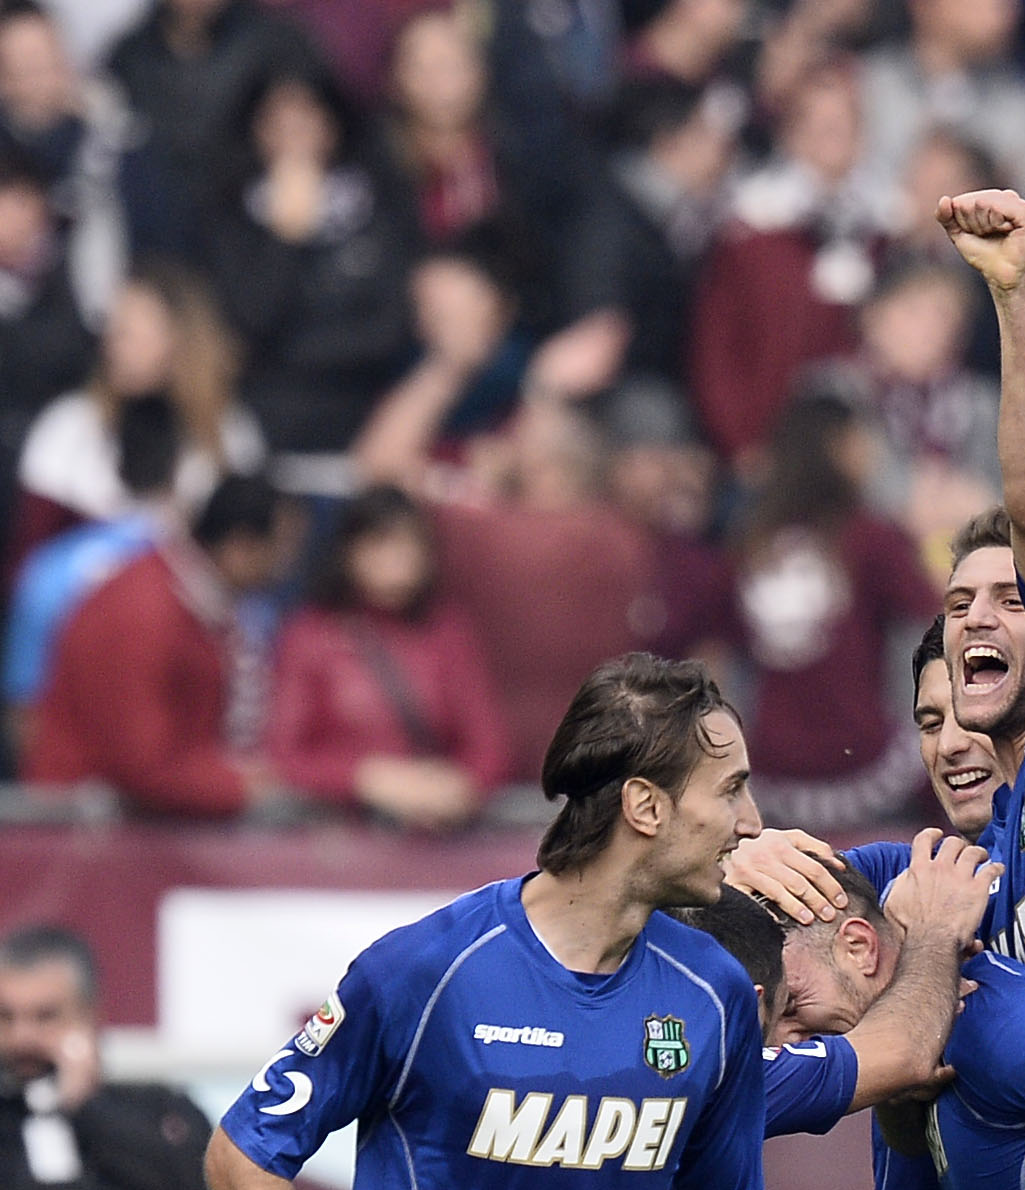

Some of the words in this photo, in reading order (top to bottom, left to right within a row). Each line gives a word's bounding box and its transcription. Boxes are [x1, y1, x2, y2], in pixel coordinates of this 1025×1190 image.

[297, 1030, 316, 1053] TIM
[473, 1023, 564, 1048] sportika
[467, 1087, 688, 1171] MAPEI
